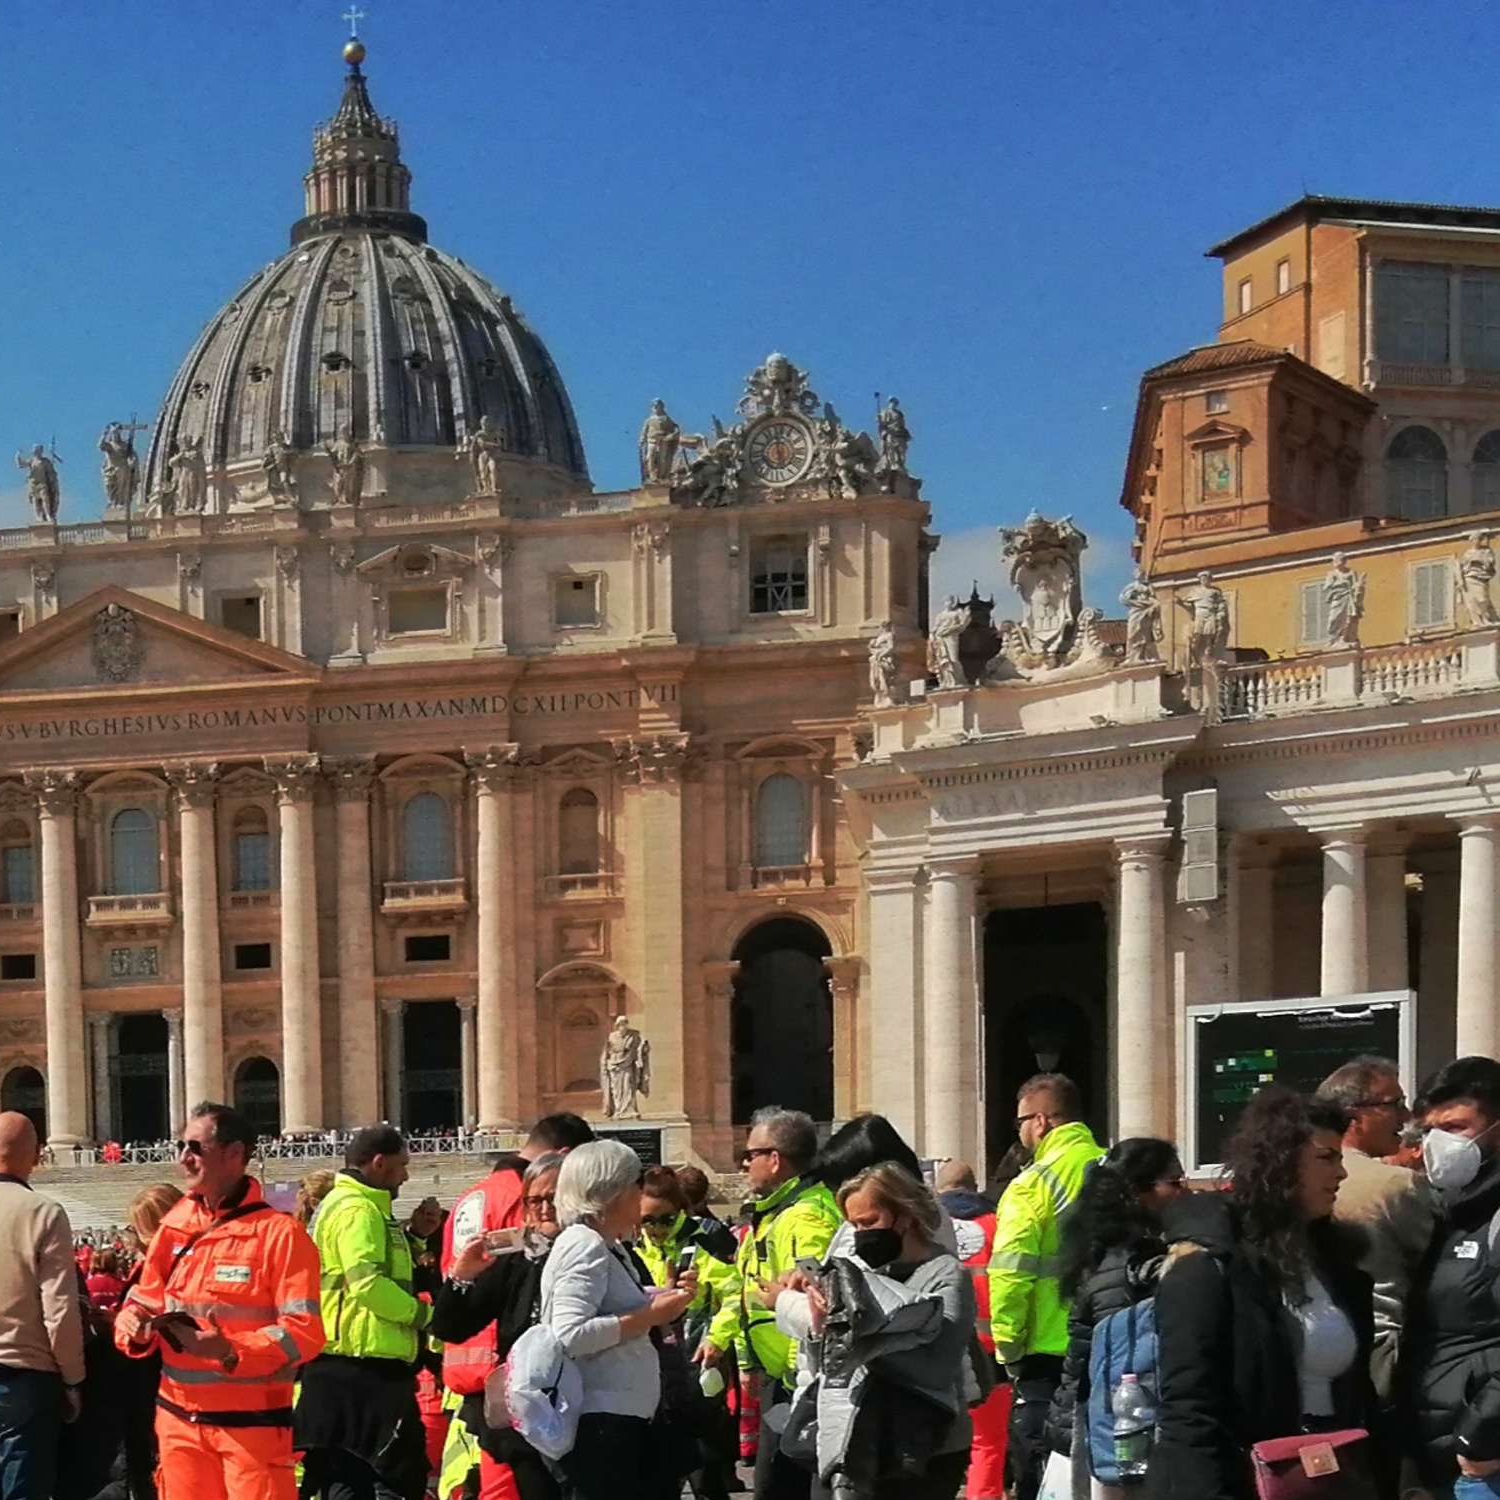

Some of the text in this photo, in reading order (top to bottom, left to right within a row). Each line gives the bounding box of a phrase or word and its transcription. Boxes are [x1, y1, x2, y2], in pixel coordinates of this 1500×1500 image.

[39, 713, 182, 739] BVRGHESIVS
[188, 705, 308, 730] ROMANVS
[315, 703, 378, 724] PONT
[378, 701, 431, 720] MAX
[574, 689, 638, 710] PONT
